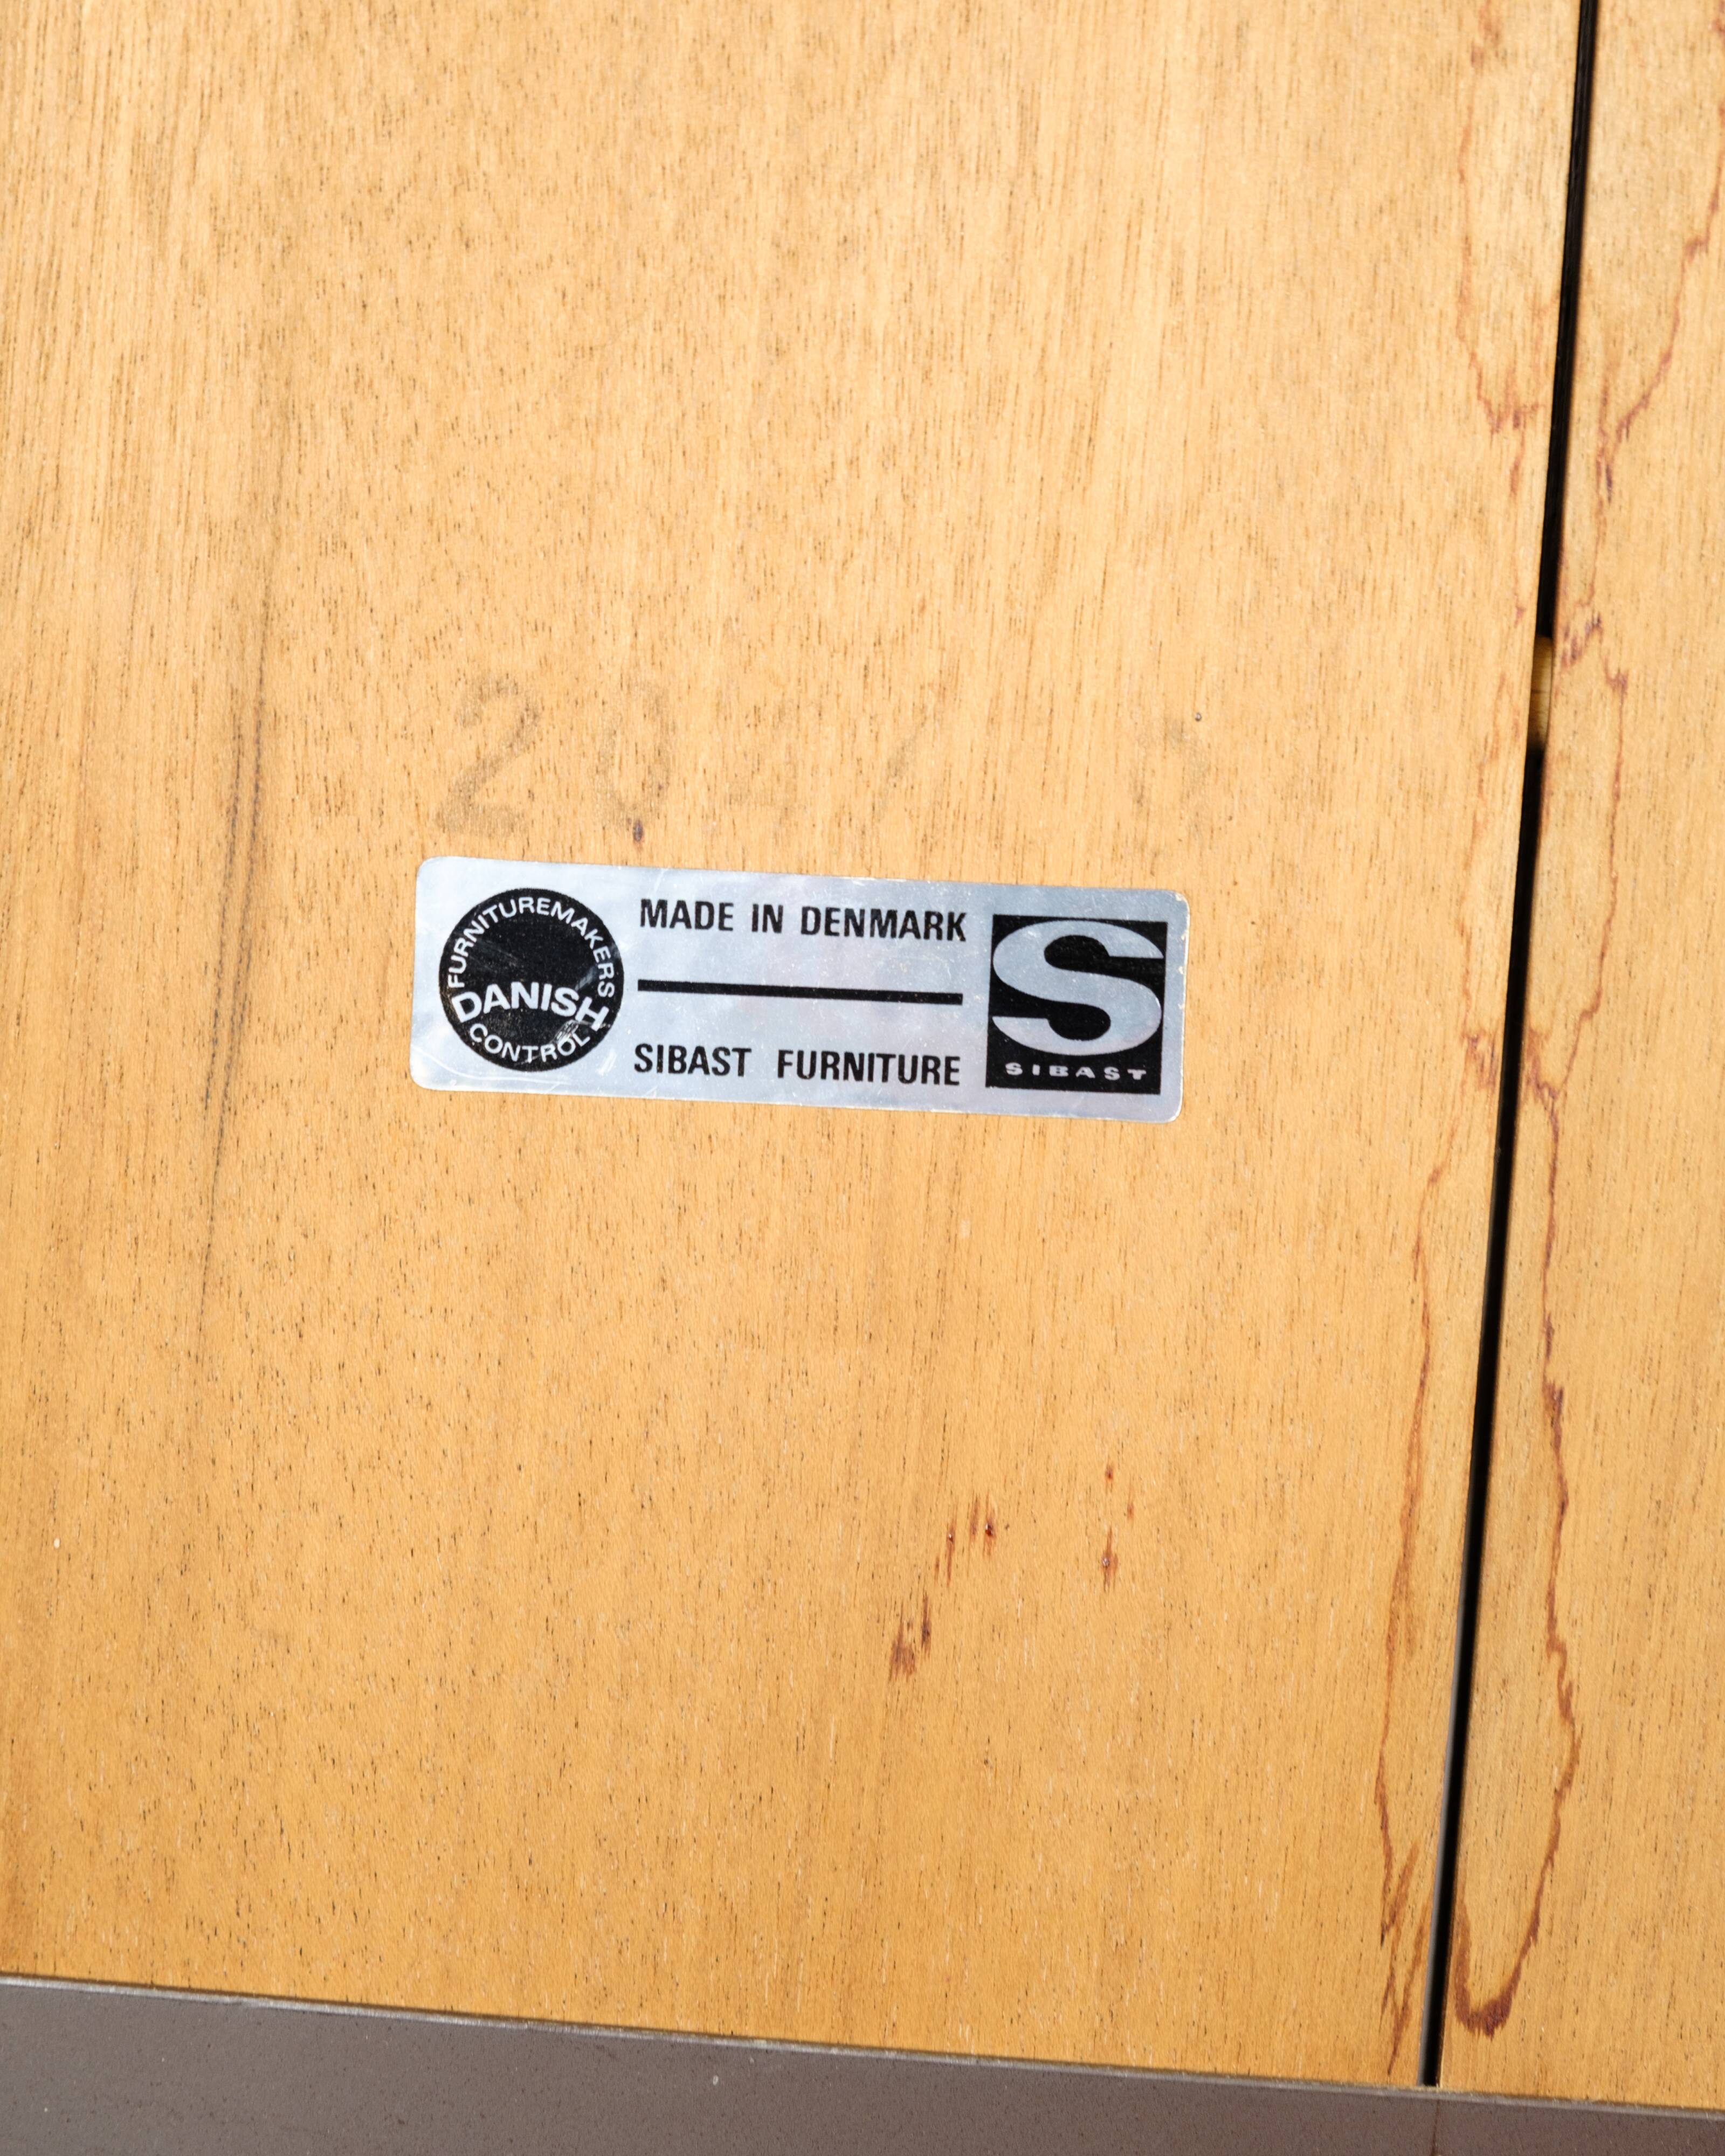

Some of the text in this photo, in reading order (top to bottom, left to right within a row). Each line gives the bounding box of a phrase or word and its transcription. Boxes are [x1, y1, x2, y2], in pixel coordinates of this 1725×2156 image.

[640, 899, 967, 942] MADE IN DENMARK
[448, 896, 615, 998] FURNITUREMAKERS
[451, 982, 610, 1031] DANISH
[469, 1024, 591, 1063] CONTROL
[634, 1043, 961, 1086] SIBAST FURNITURE
[1005, 1062, 1147, 1081] SIBAST
